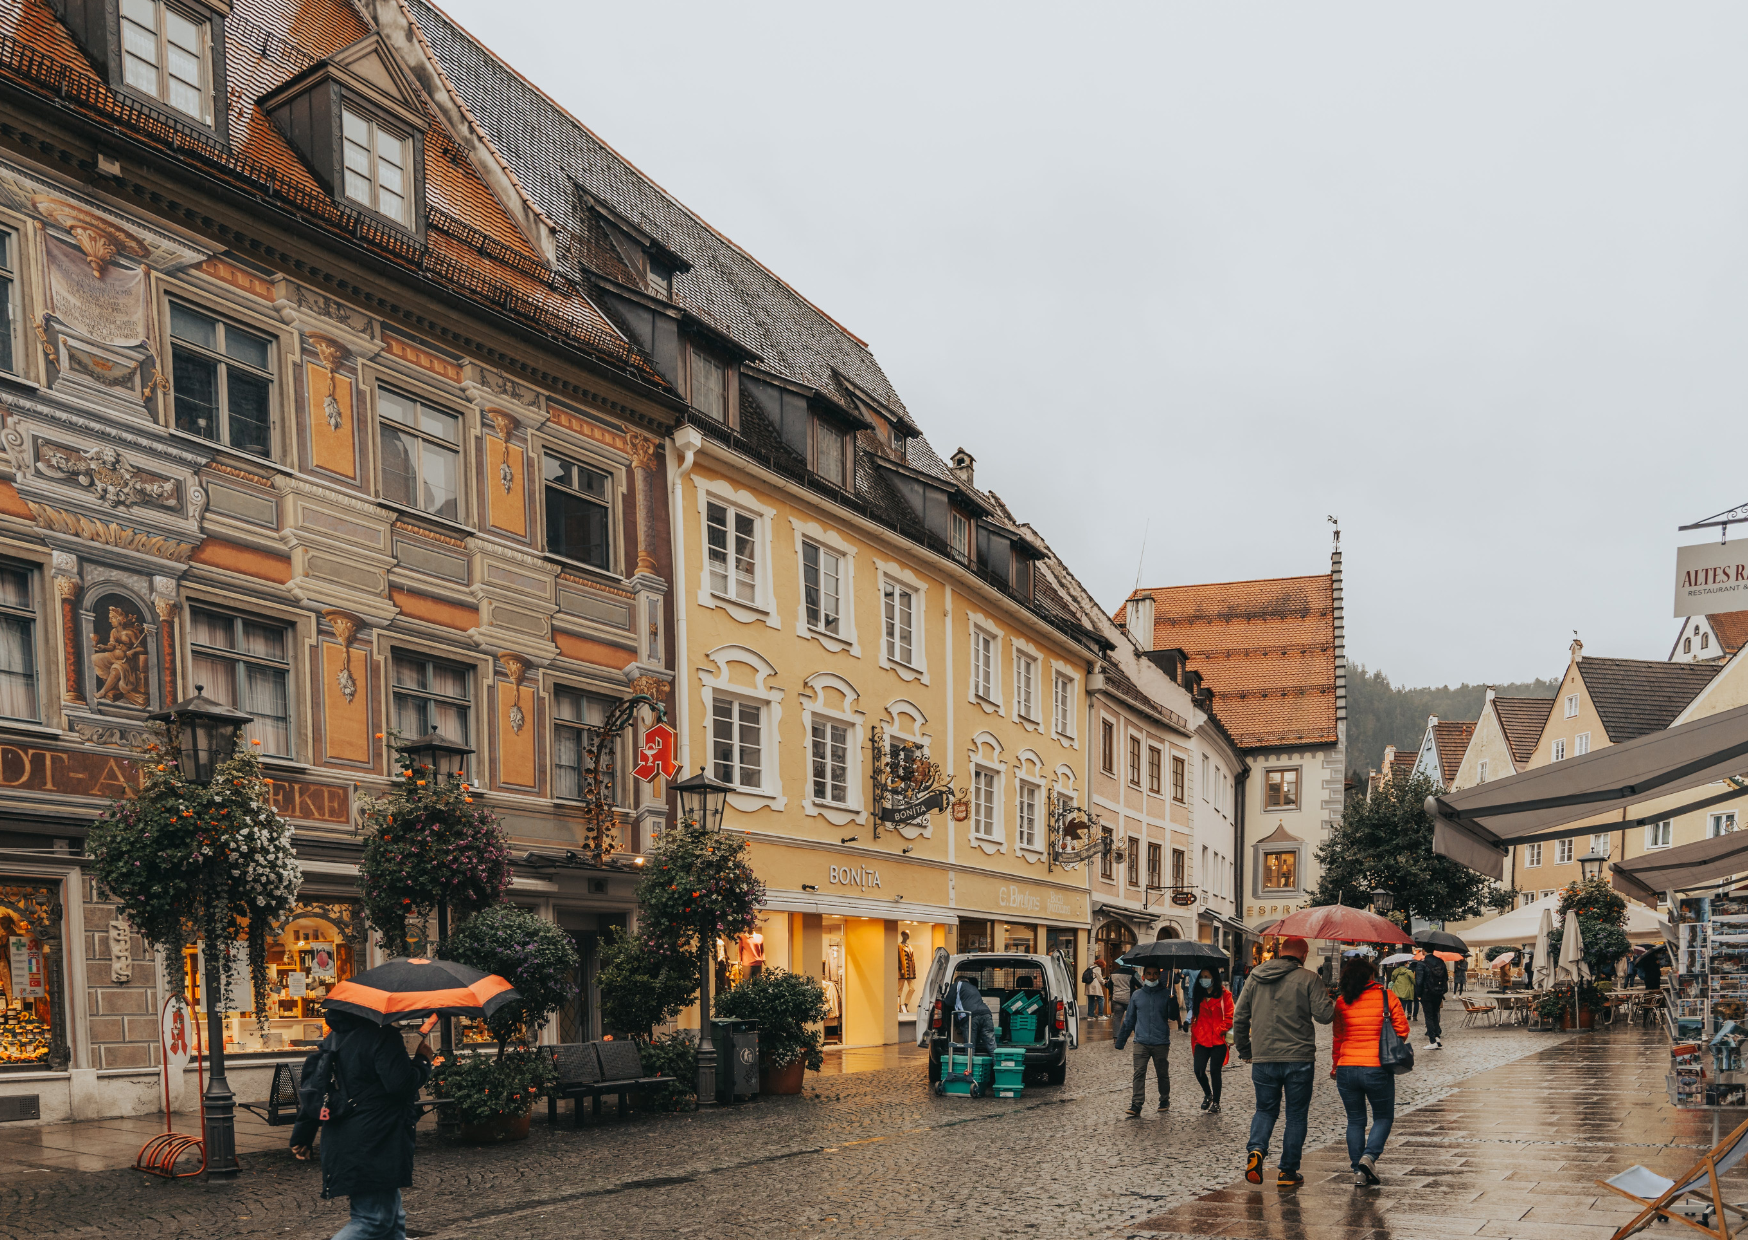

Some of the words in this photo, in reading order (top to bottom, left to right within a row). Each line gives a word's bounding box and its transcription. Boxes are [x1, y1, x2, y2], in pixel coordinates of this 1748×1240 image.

[1682, 565, 1730, 588] ALTES
[1735, 564, 1748, 582] R
[1688, 585, 1741, 596] RESTAURANT
